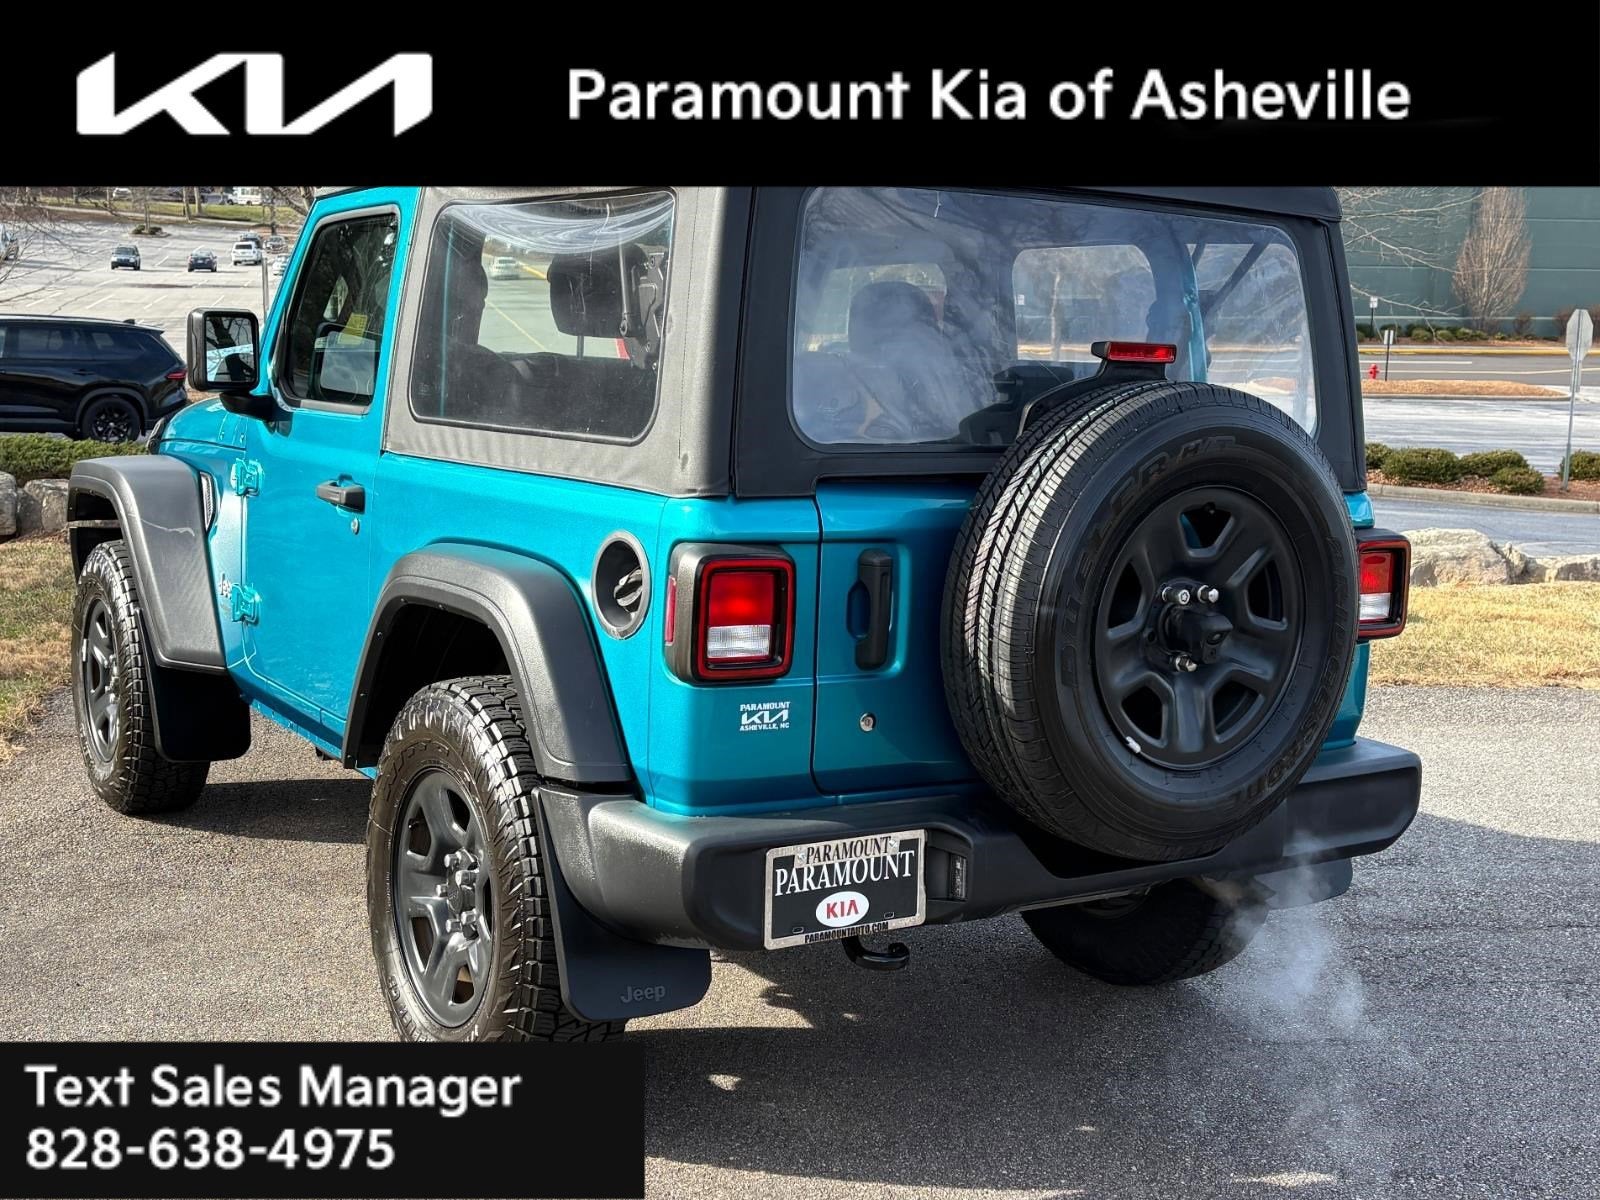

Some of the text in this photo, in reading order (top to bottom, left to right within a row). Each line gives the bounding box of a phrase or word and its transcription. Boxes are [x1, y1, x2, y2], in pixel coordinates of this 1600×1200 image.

[739, 701, 791, 712] PARAMOUNT
[779, 721, 790, 729] NC
[806, 836, 892, 864] PARAMOUNT
[775, 850, 915, 897] PARAMOUNT
[826, 899, 860, 920] KIA
[620, 985, 666, 1004] Jeep
